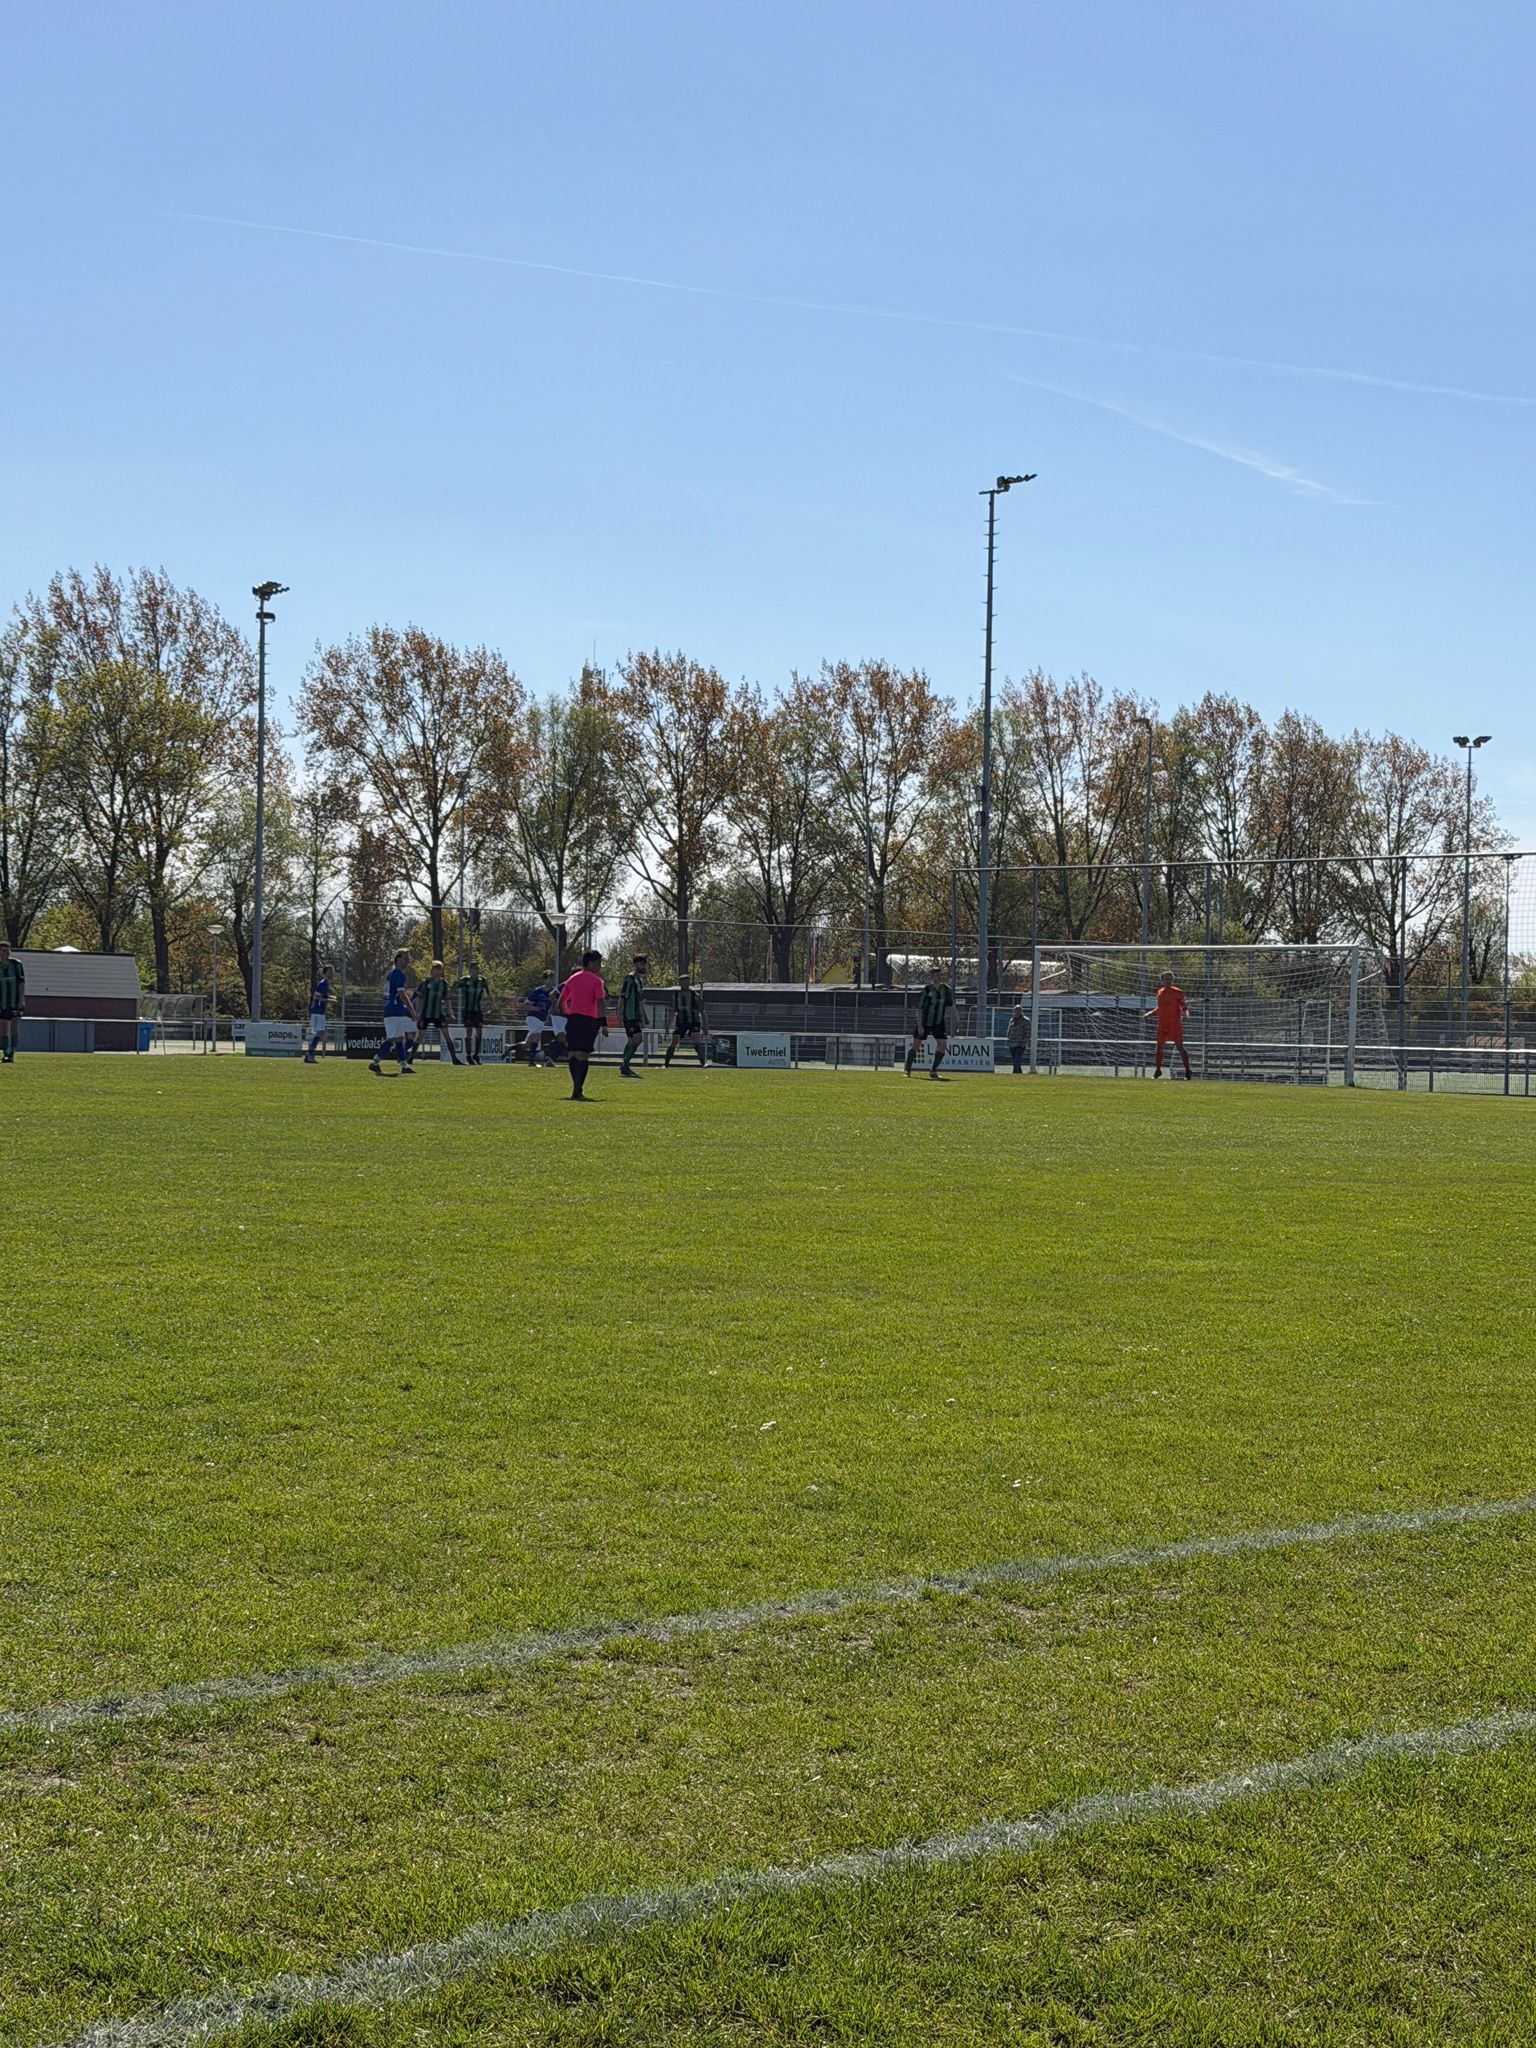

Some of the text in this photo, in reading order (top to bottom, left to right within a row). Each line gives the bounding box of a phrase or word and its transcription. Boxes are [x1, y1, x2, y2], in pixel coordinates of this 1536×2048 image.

[268, 1031, 293, 1040] paape
[745, 1046, 786, 1057] TweEmiel
[927, 1044, 990, 1057] LNDMAN
